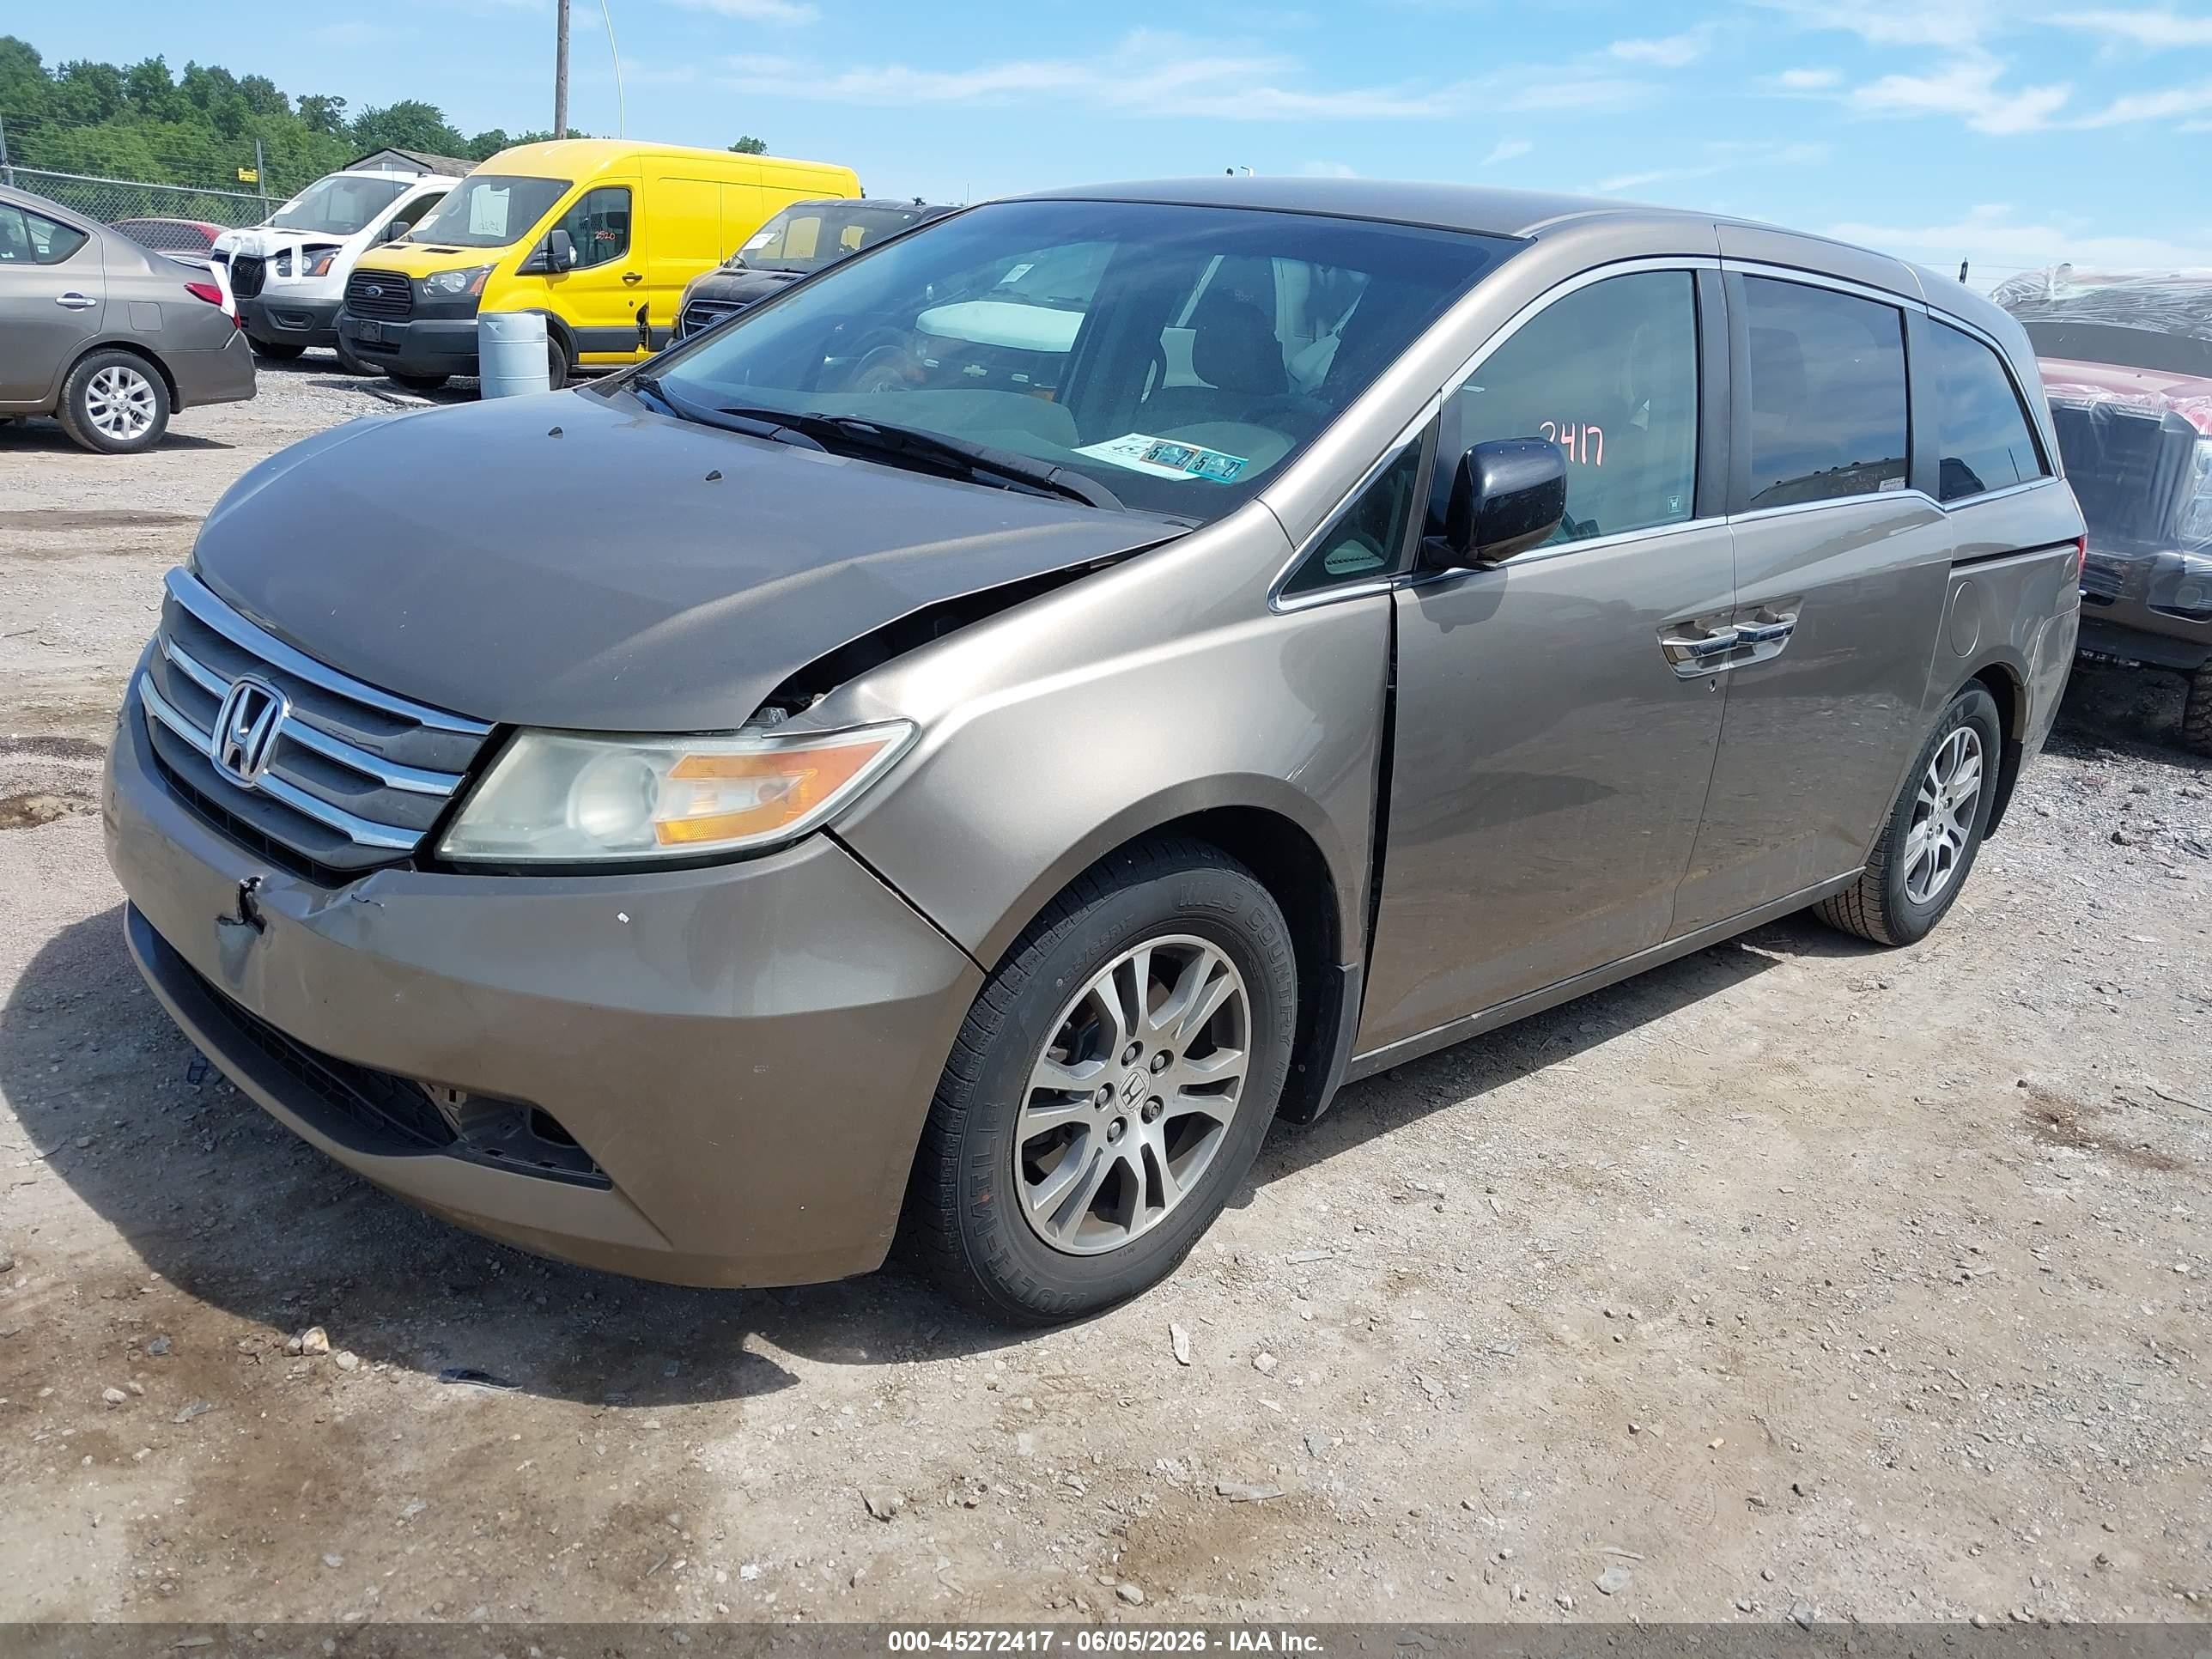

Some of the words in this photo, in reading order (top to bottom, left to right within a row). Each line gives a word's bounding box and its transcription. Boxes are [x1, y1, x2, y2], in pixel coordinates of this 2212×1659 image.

[594, 230, 616, 240] 2520
[1174, 449, 1195, 468] 27
[1221, 460, 1242, 478] 27
[1244, 907, 1293, 1049] COUNTRY
[968, 1102, 1087, 1316] MULTI-MILE
